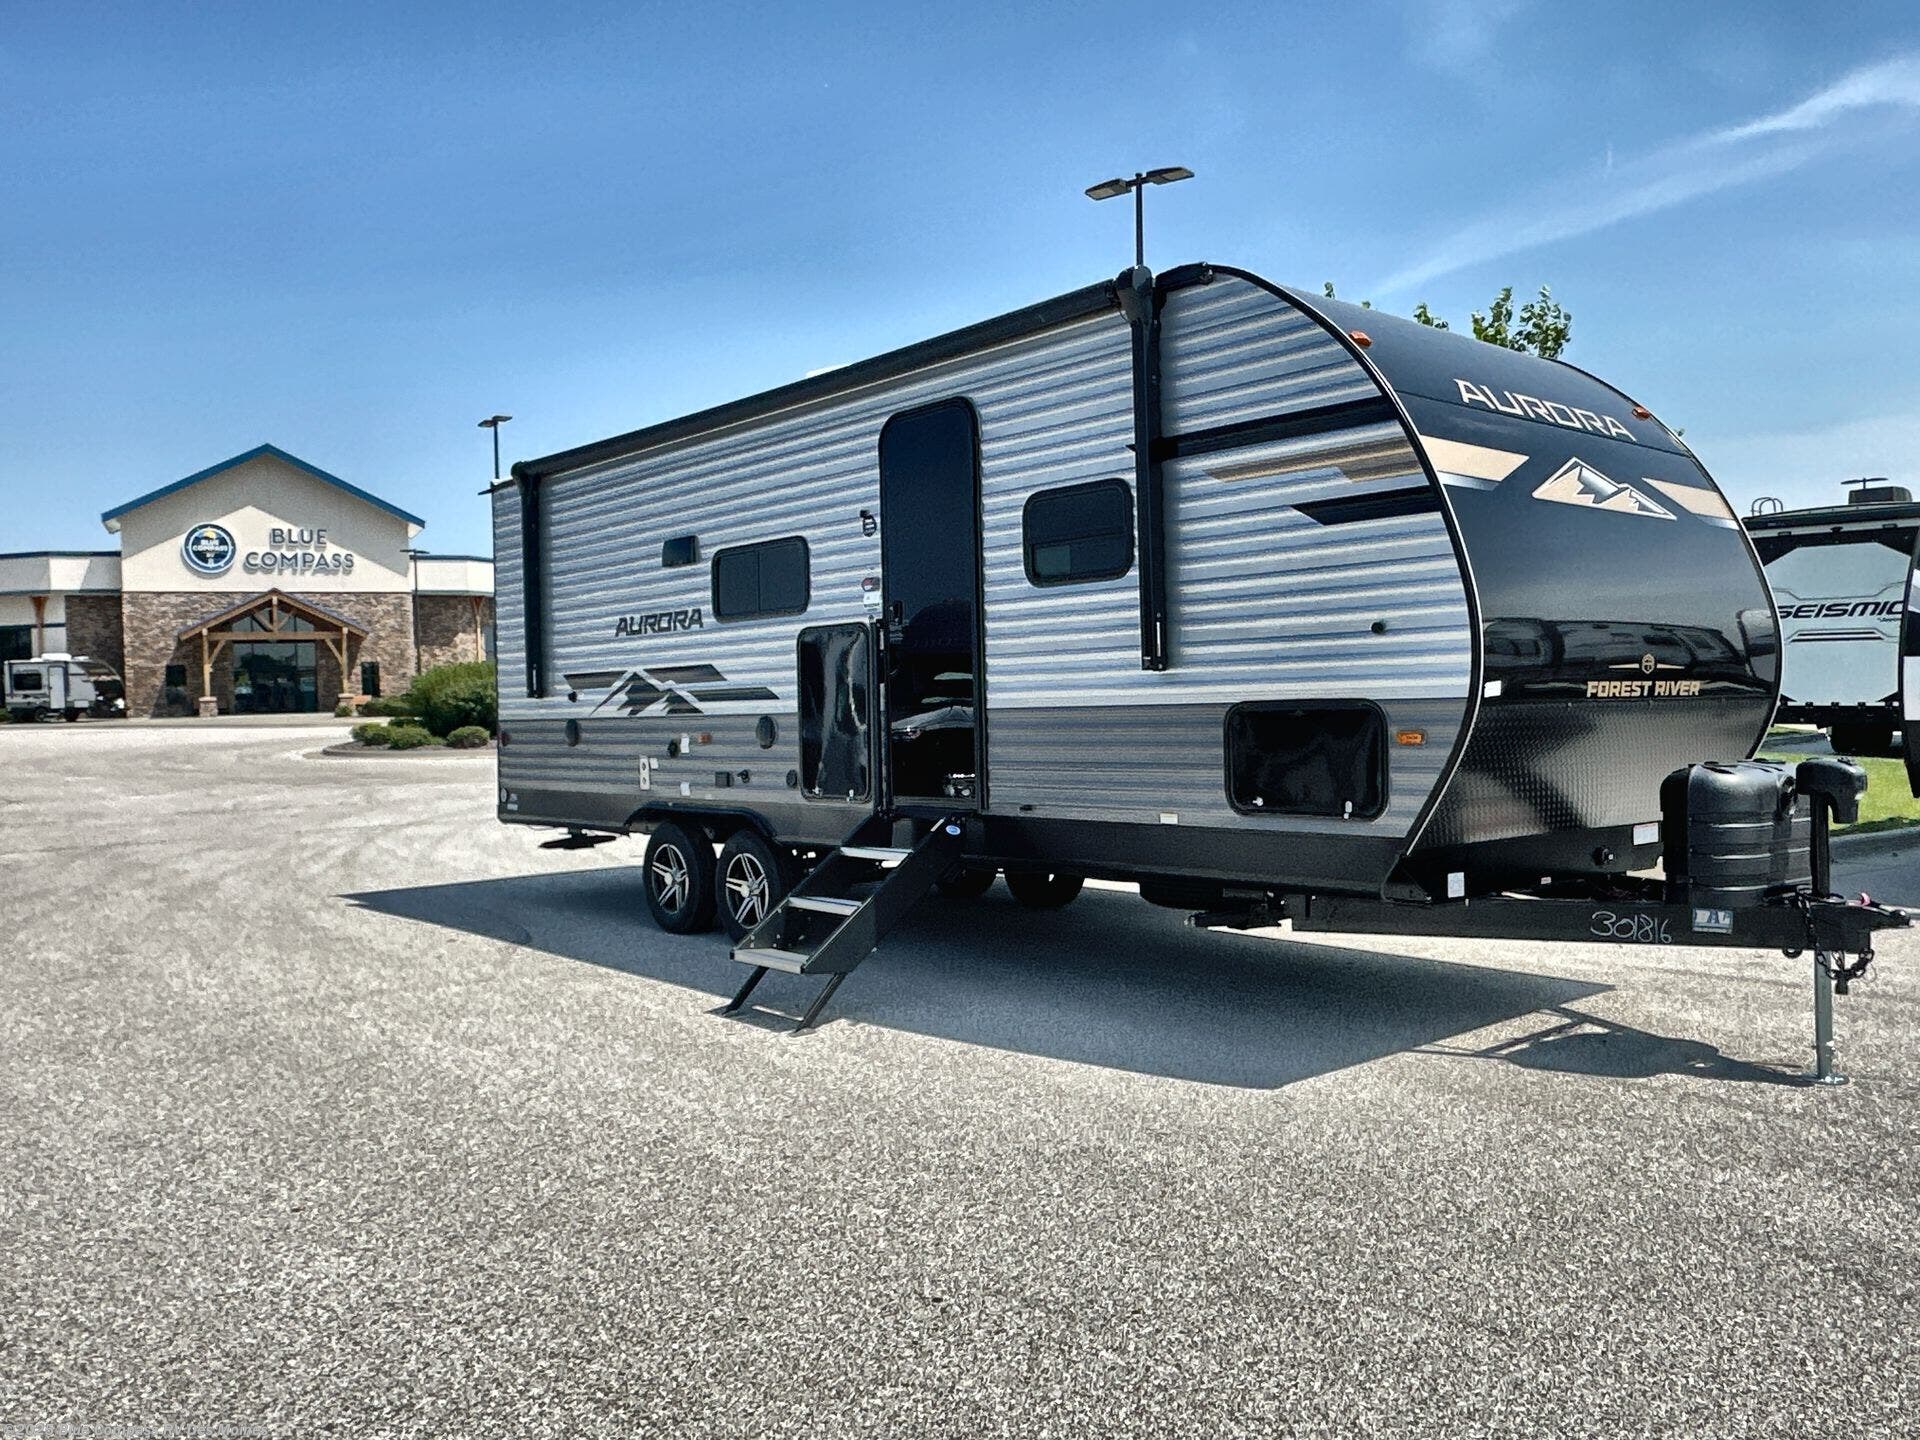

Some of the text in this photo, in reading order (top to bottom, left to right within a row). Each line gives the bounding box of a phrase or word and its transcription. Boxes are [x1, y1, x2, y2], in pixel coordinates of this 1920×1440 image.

[1454, 378, 1637, 442] AURORA
[271, 528, 328, 545] BLUE
[245, 551, 354, 569] COMPASS
[1777, 600, 1904, 619] SEISMIC
[615, 608, 704, 637] AURORA
[1586, 680, 1701, 697] FOREST RIVER
[1590, 910, 1673, 944] 301816
